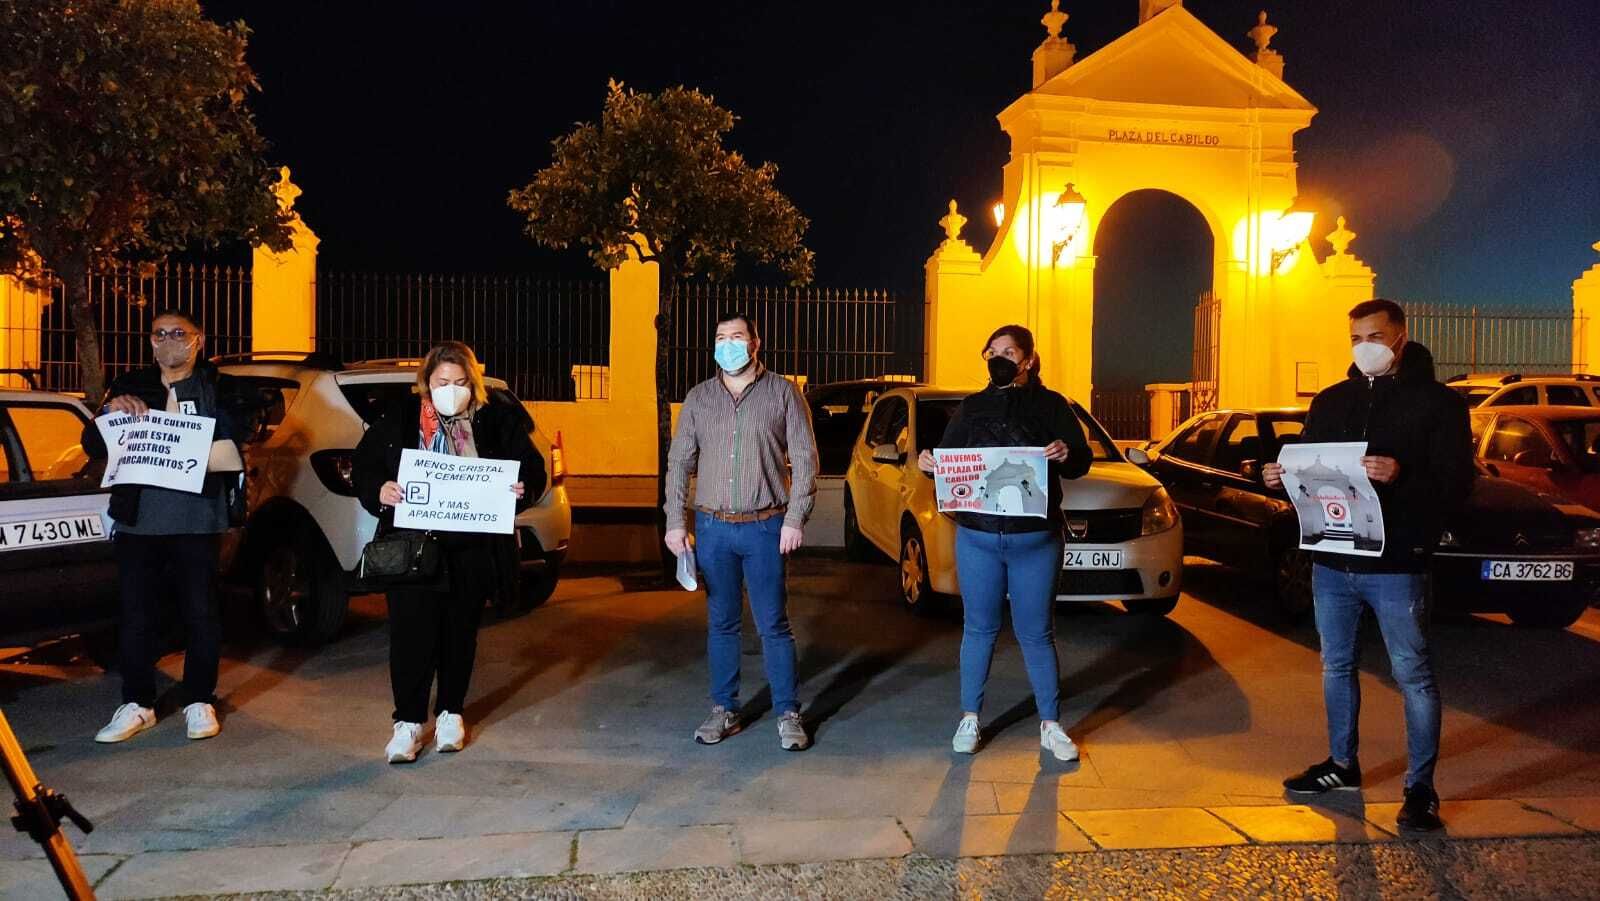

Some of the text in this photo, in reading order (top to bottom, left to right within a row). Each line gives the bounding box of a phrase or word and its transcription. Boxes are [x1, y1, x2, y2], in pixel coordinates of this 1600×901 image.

[1108, 129, 1220, 145] PLAZA DEL CABILDO
[152, 416, 163, 425] DE
[164, 418, 202, 431] CUENTOS
[126, 442, 171, 455] NUESTROS
[940, 453, 983, 463] SALVEMOS
[414, 458, 504, 473] MENOS CRISTAL
[936, 463, 987, 475] LA PLAZA DEL
[425, 470, 433, 479] Y
[438, 500, 471, 510] Y MAS
[407, 509, 499, 522] APARCAMIENTOS
[14, 520, 72, 544] 7430
[74, 517, 102, 538] ML
[1092, 552, 1119, 566] GNJ
[1493, 562, 1511, 578] CA
[1516, 563, 1552, 579] 3762
